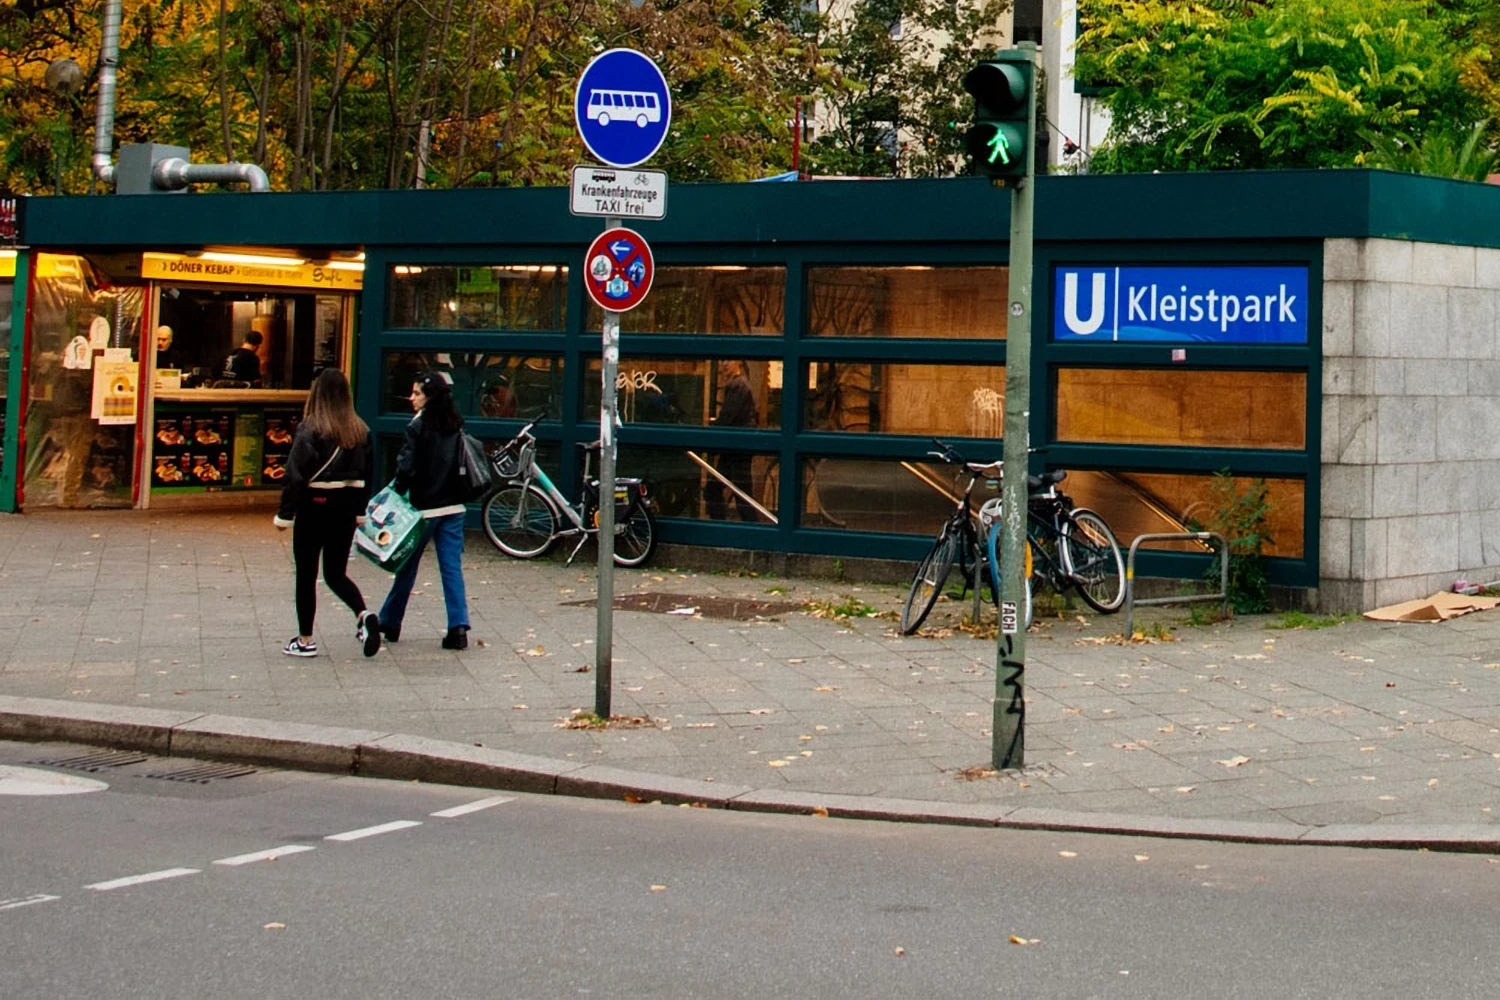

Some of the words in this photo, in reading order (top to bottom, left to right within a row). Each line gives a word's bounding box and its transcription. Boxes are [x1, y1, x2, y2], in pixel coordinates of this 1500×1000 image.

[582, 184, 657, 203] Krankenfahrzeuge
[595, 199, 620, 214] TAXI
[625, 200, 644, 215] frei
[170, 260, 203, 273] DÖNER
[205, 262, 234, 275] KEBAP
[1064, 272, 1105, 335] U
[1128, 283, 1297, 332] Kleistpark
[1002, 602, 1016, 630] FACH
